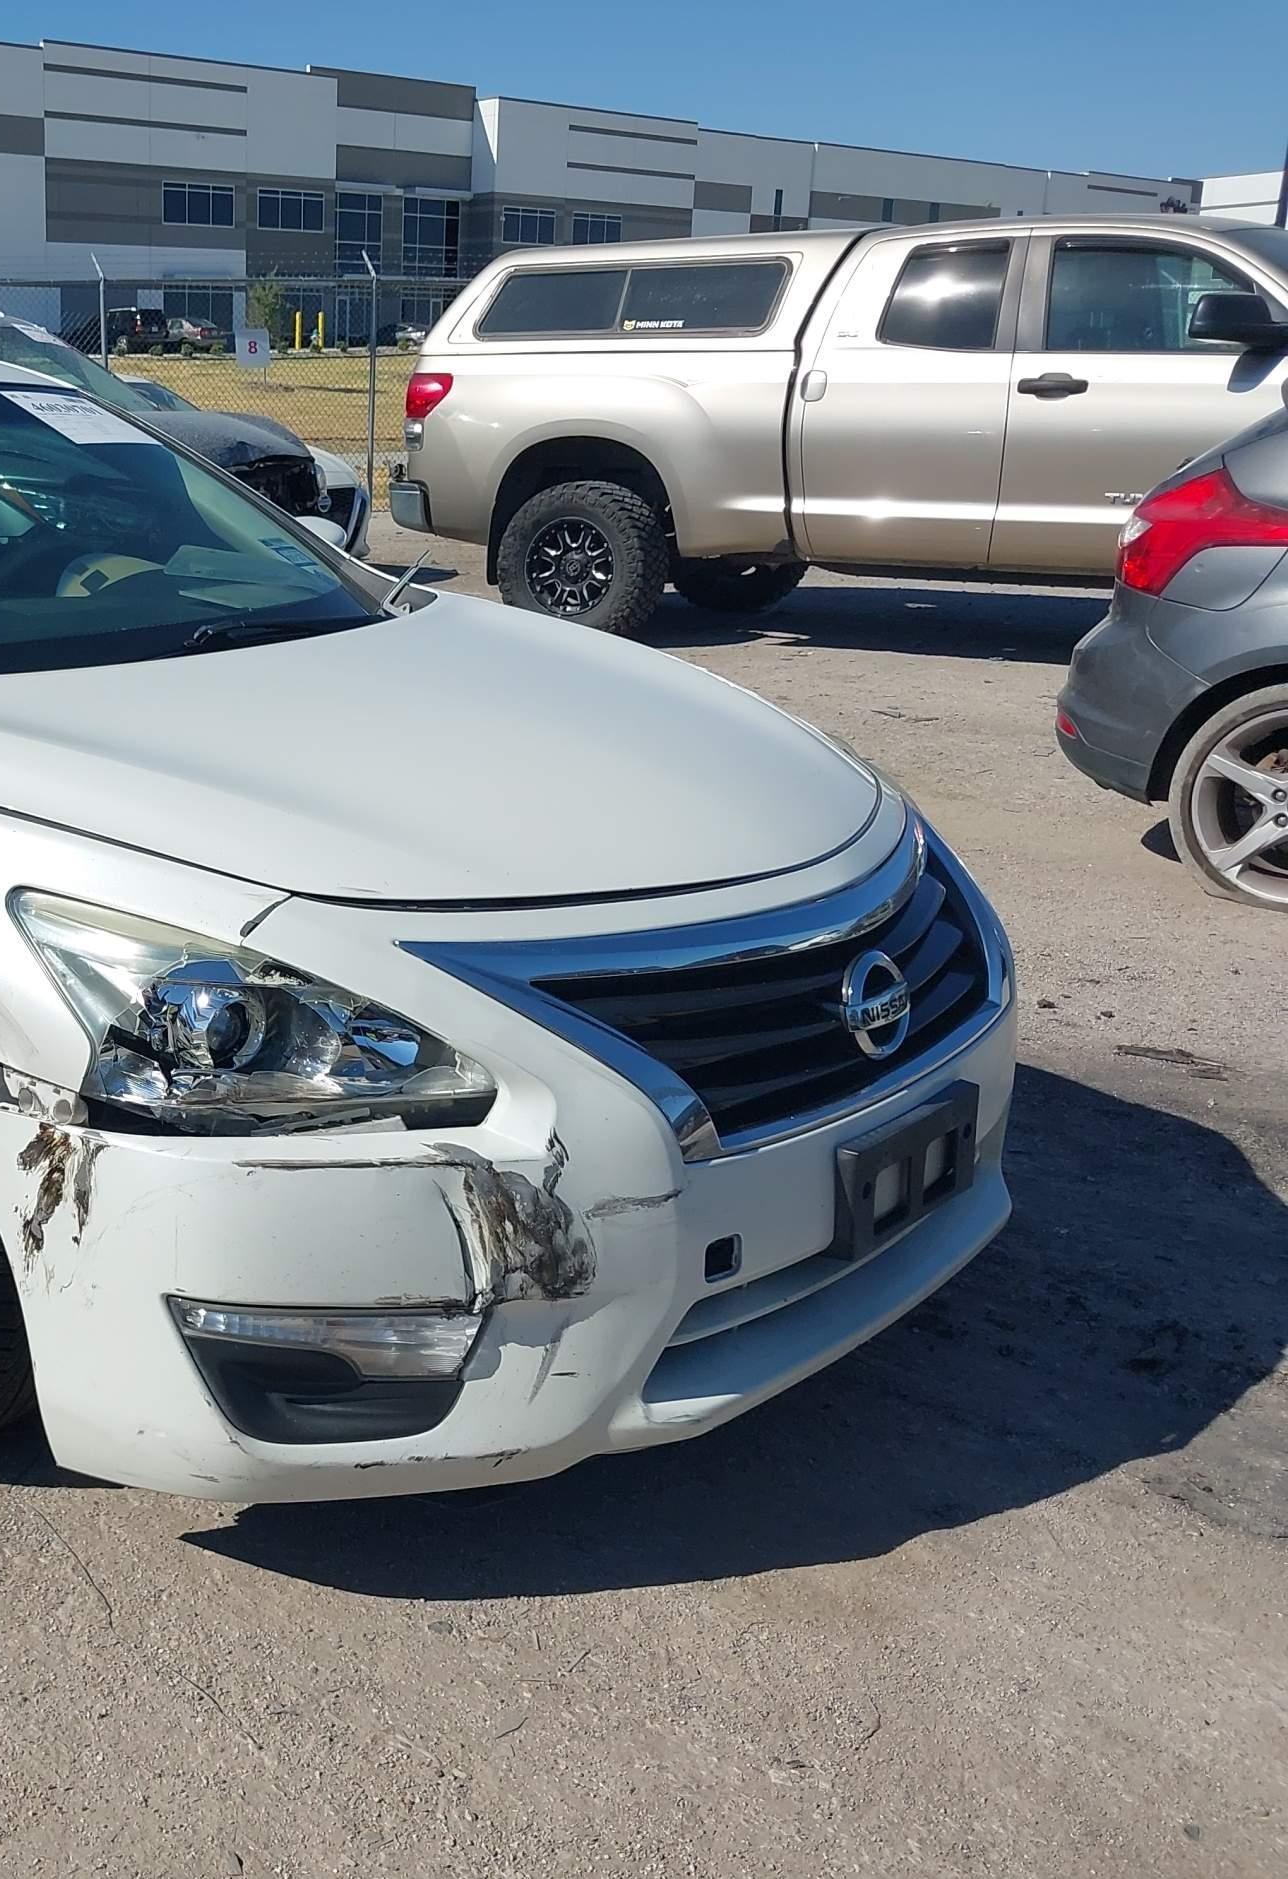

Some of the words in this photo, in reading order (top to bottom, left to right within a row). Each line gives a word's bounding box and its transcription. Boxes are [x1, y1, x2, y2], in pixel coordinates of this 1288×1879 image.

[636, 320, 659, 328] MINN
[660, 320, 684, 328] KOTA
[248, 341, 258, 353] 8
[860, 994, 909, 1025] NISSA
